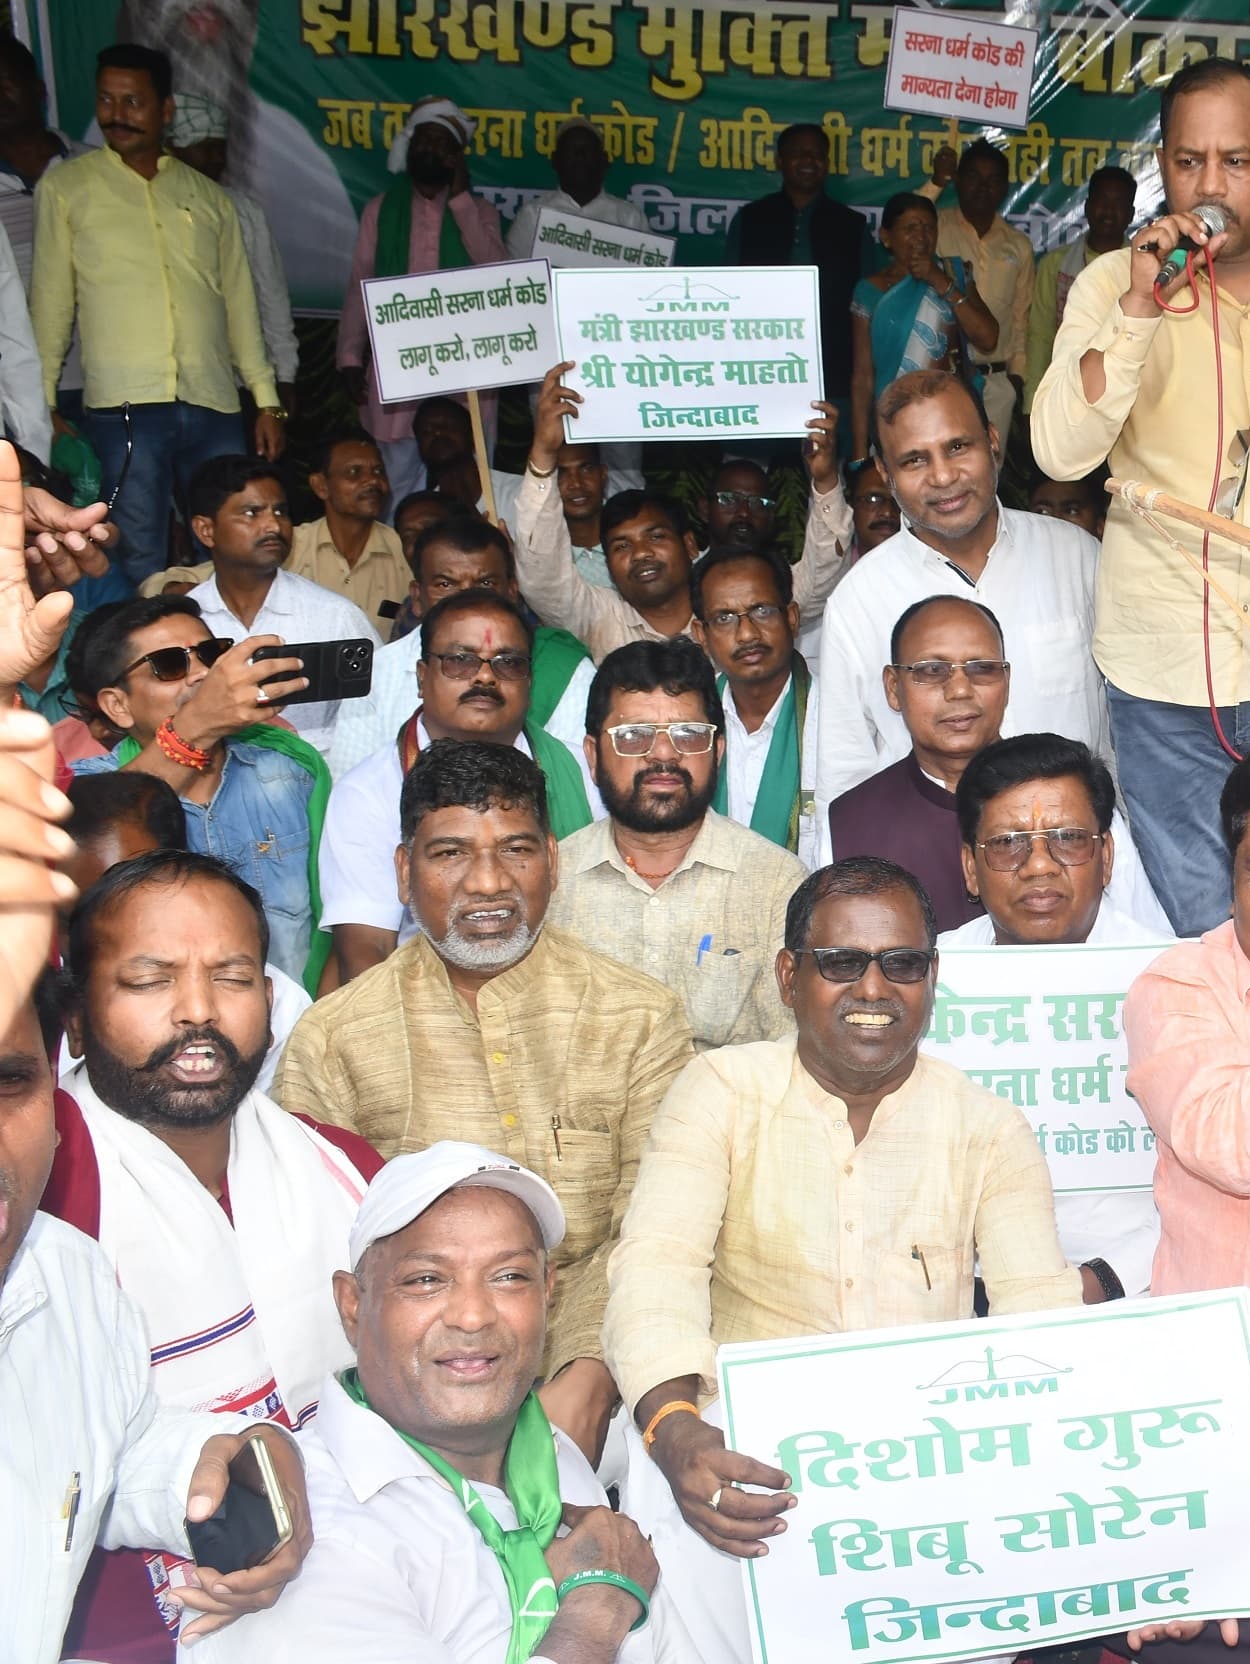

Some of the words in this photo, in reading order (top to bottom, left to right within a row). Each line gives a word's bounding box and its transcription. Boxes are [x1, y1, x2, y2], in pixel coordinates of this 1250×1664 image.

[904, 31, 944, 56] सरना
[946, 32, 972, 60] धर्म
[972, 37, 1002, 67] कोड
[1004, 40, 1026, 68] की
[901, 74, 953, 101] मान्यता
[955, 74, 983, 105] देना
[983, 80, 1018, 111] होगा
[318, 98, 375, 149] जब
[463, 108, 527, 159] रना
[861, 112, 914, 179] धर्म
[538, 222, 593, 256] आदिवासी
[623, 244, 646, 267] धर्म
[375, 288, 444, 325] आदिवासी
[445, 290, 486, 316] सरना
[487, 277, 513, 311] धर्म
[514, 276, 548, 306] कोड
[645, 302, 730, 313] JMM
[578, 313, 623, 342] मंत्री
[626, 318, 727, 343] झारखण्ड
[730, 318, 806, 341] सरकार
[398, 343, 439, 376] लागू
[472, 334, 513, 365] लागू
[508, 323, 538, 352] करो
[580, 354, 617, 388] श्री
[621, 354, 716, 387] योगेन्द्र
[720, 352, 808, 385] माहतो
[638, 401, 760, 429] जिन्दाबाद
[1052, 1053, 1114, 1105] धर्म
[1053, 1122, 1101, 1156] कोड
[1103, 1120, 1136, 1153] को
[927, 1376, 1058, 1405] JMM
[773, 1416, 1033, 1494] दिशोम
[808, 1518, 985, 1577] शिबू
[993, 1485, 1209, 1555] सोरेन
[573, 1569, 607, 1581] J.M.M.
[840, 1568, 1194, 1651] जिन्दाबाद
